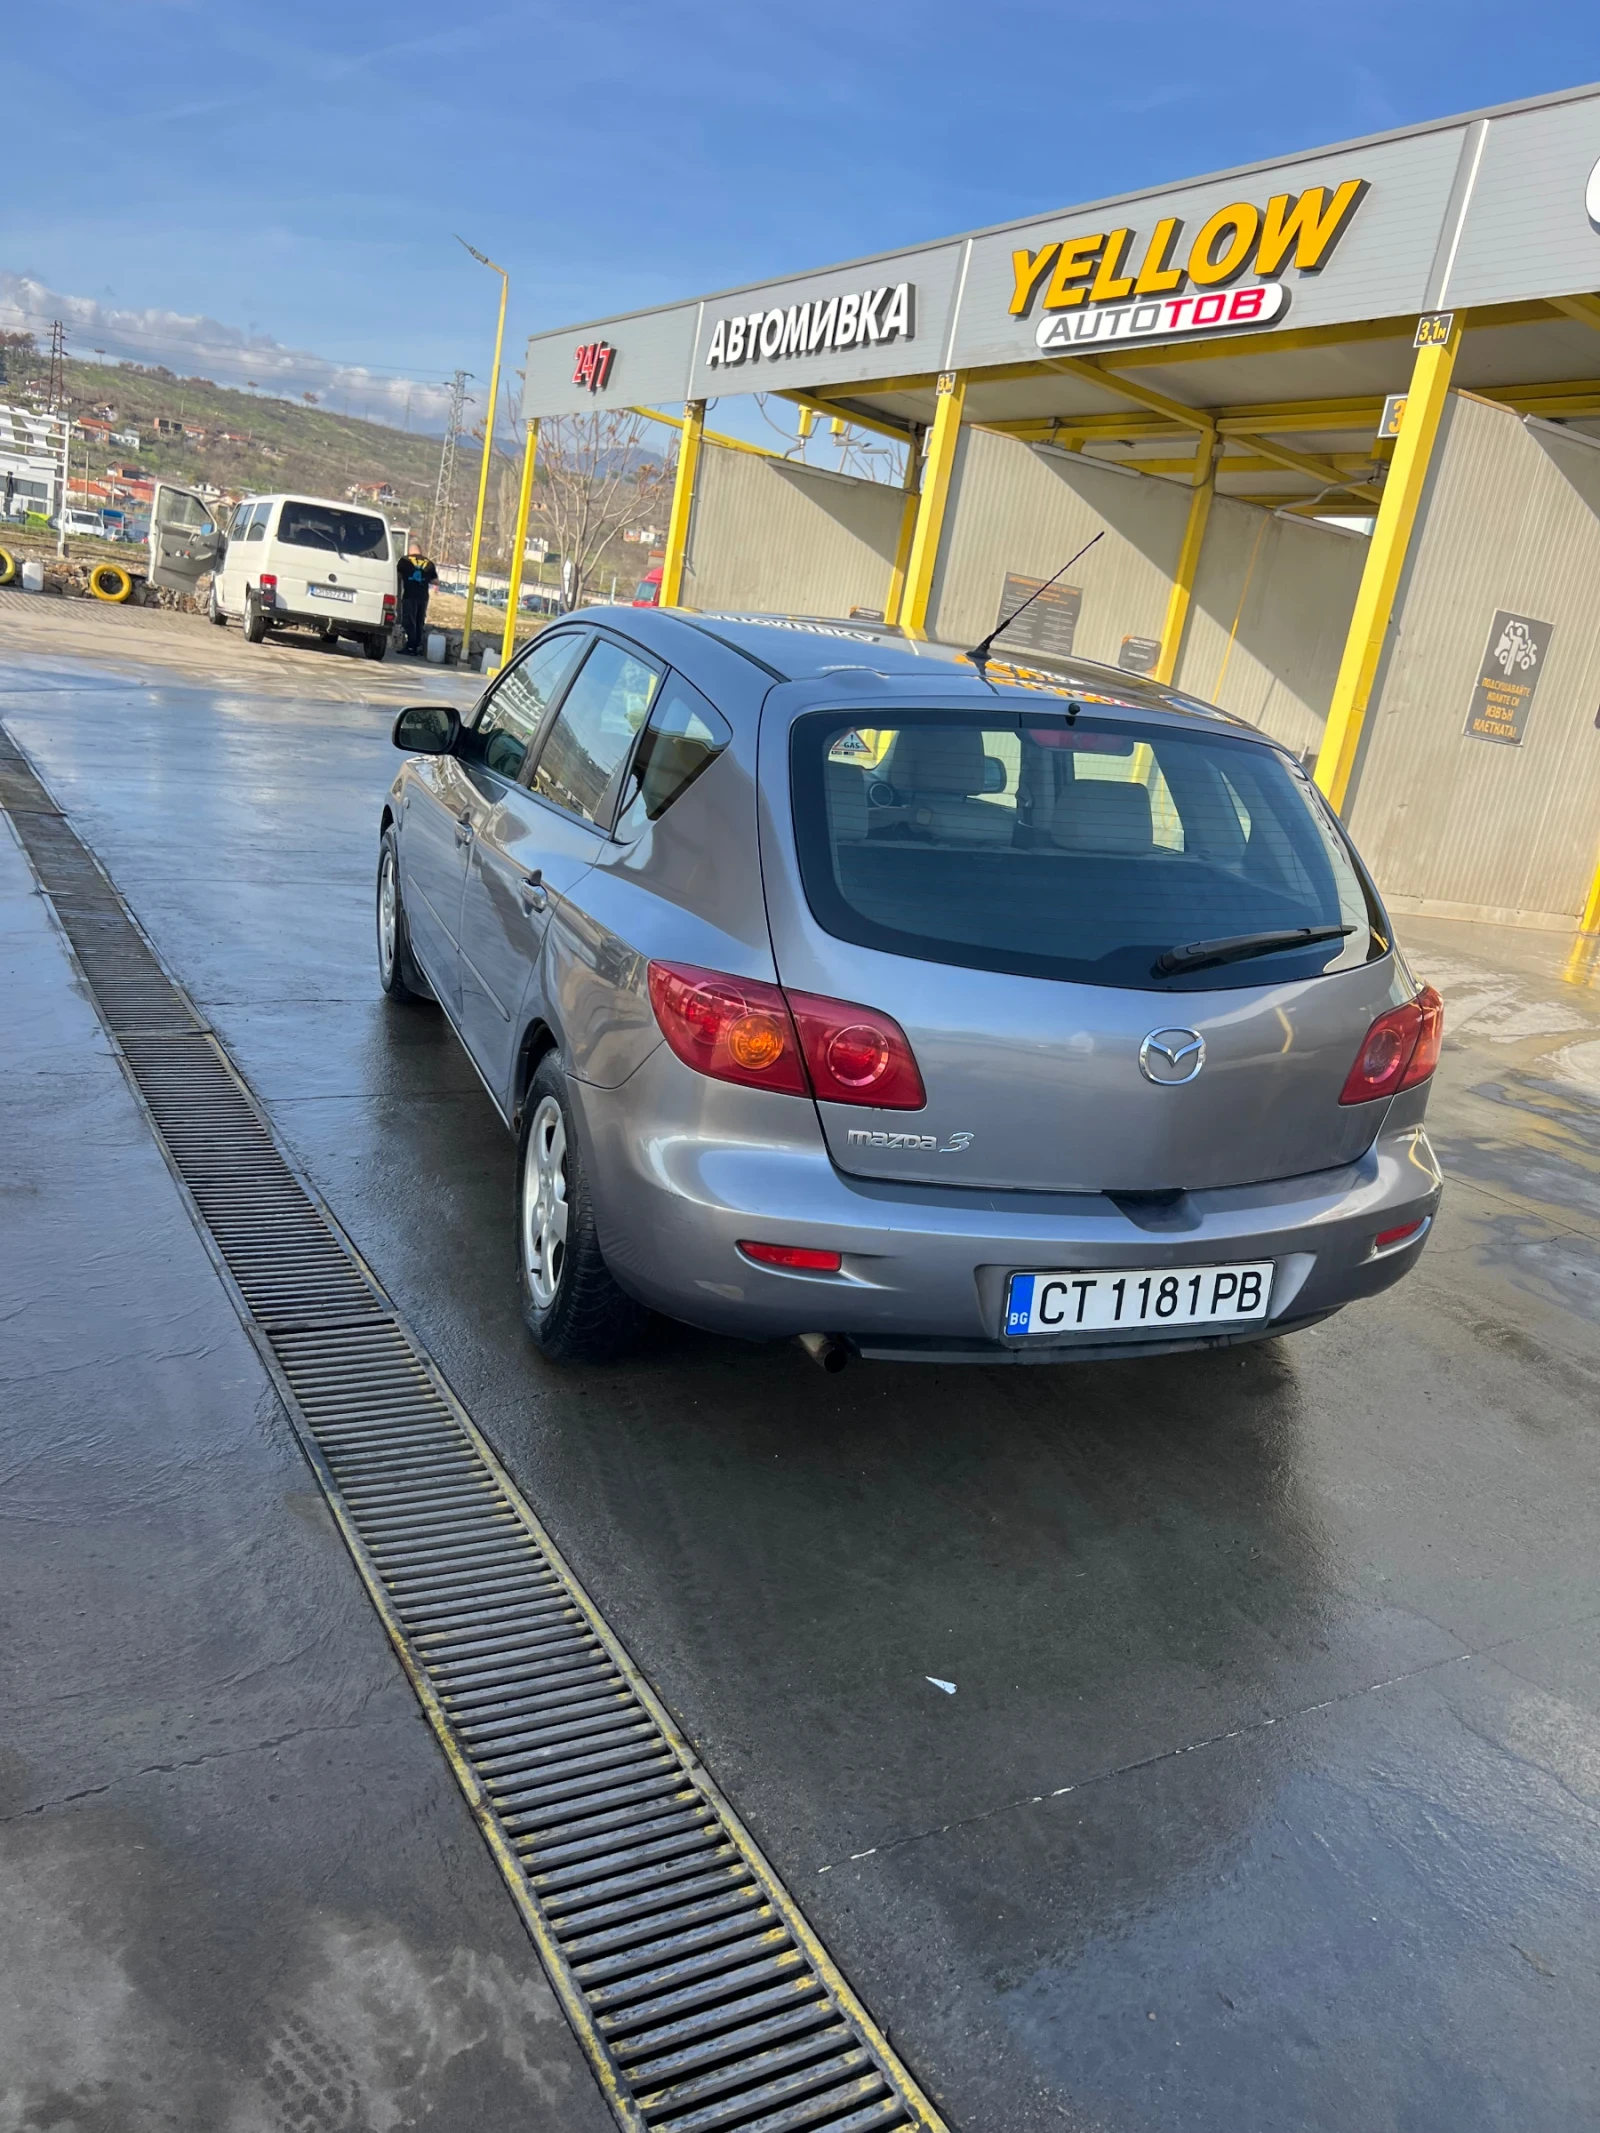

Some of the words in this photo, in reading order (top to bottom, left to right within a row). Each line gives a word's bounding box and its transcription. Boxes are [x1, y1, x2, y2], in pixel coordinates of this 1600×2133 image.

[1008, 179, 1364, 315] YELLOW
[705, 282, 910, 366] АВТОМИВКА
[1043, 287, 1266, 344] AUTOTOB
[571, 340, 612, 392] 24/7
[1473, 718, 1517, 738] КЛЕТКАТА!
[1485, 705, 1514, 721] ИЗВЪН
[843, 741, 860, 749] GAS
[1009, 1312, 1028, 1326] BG
